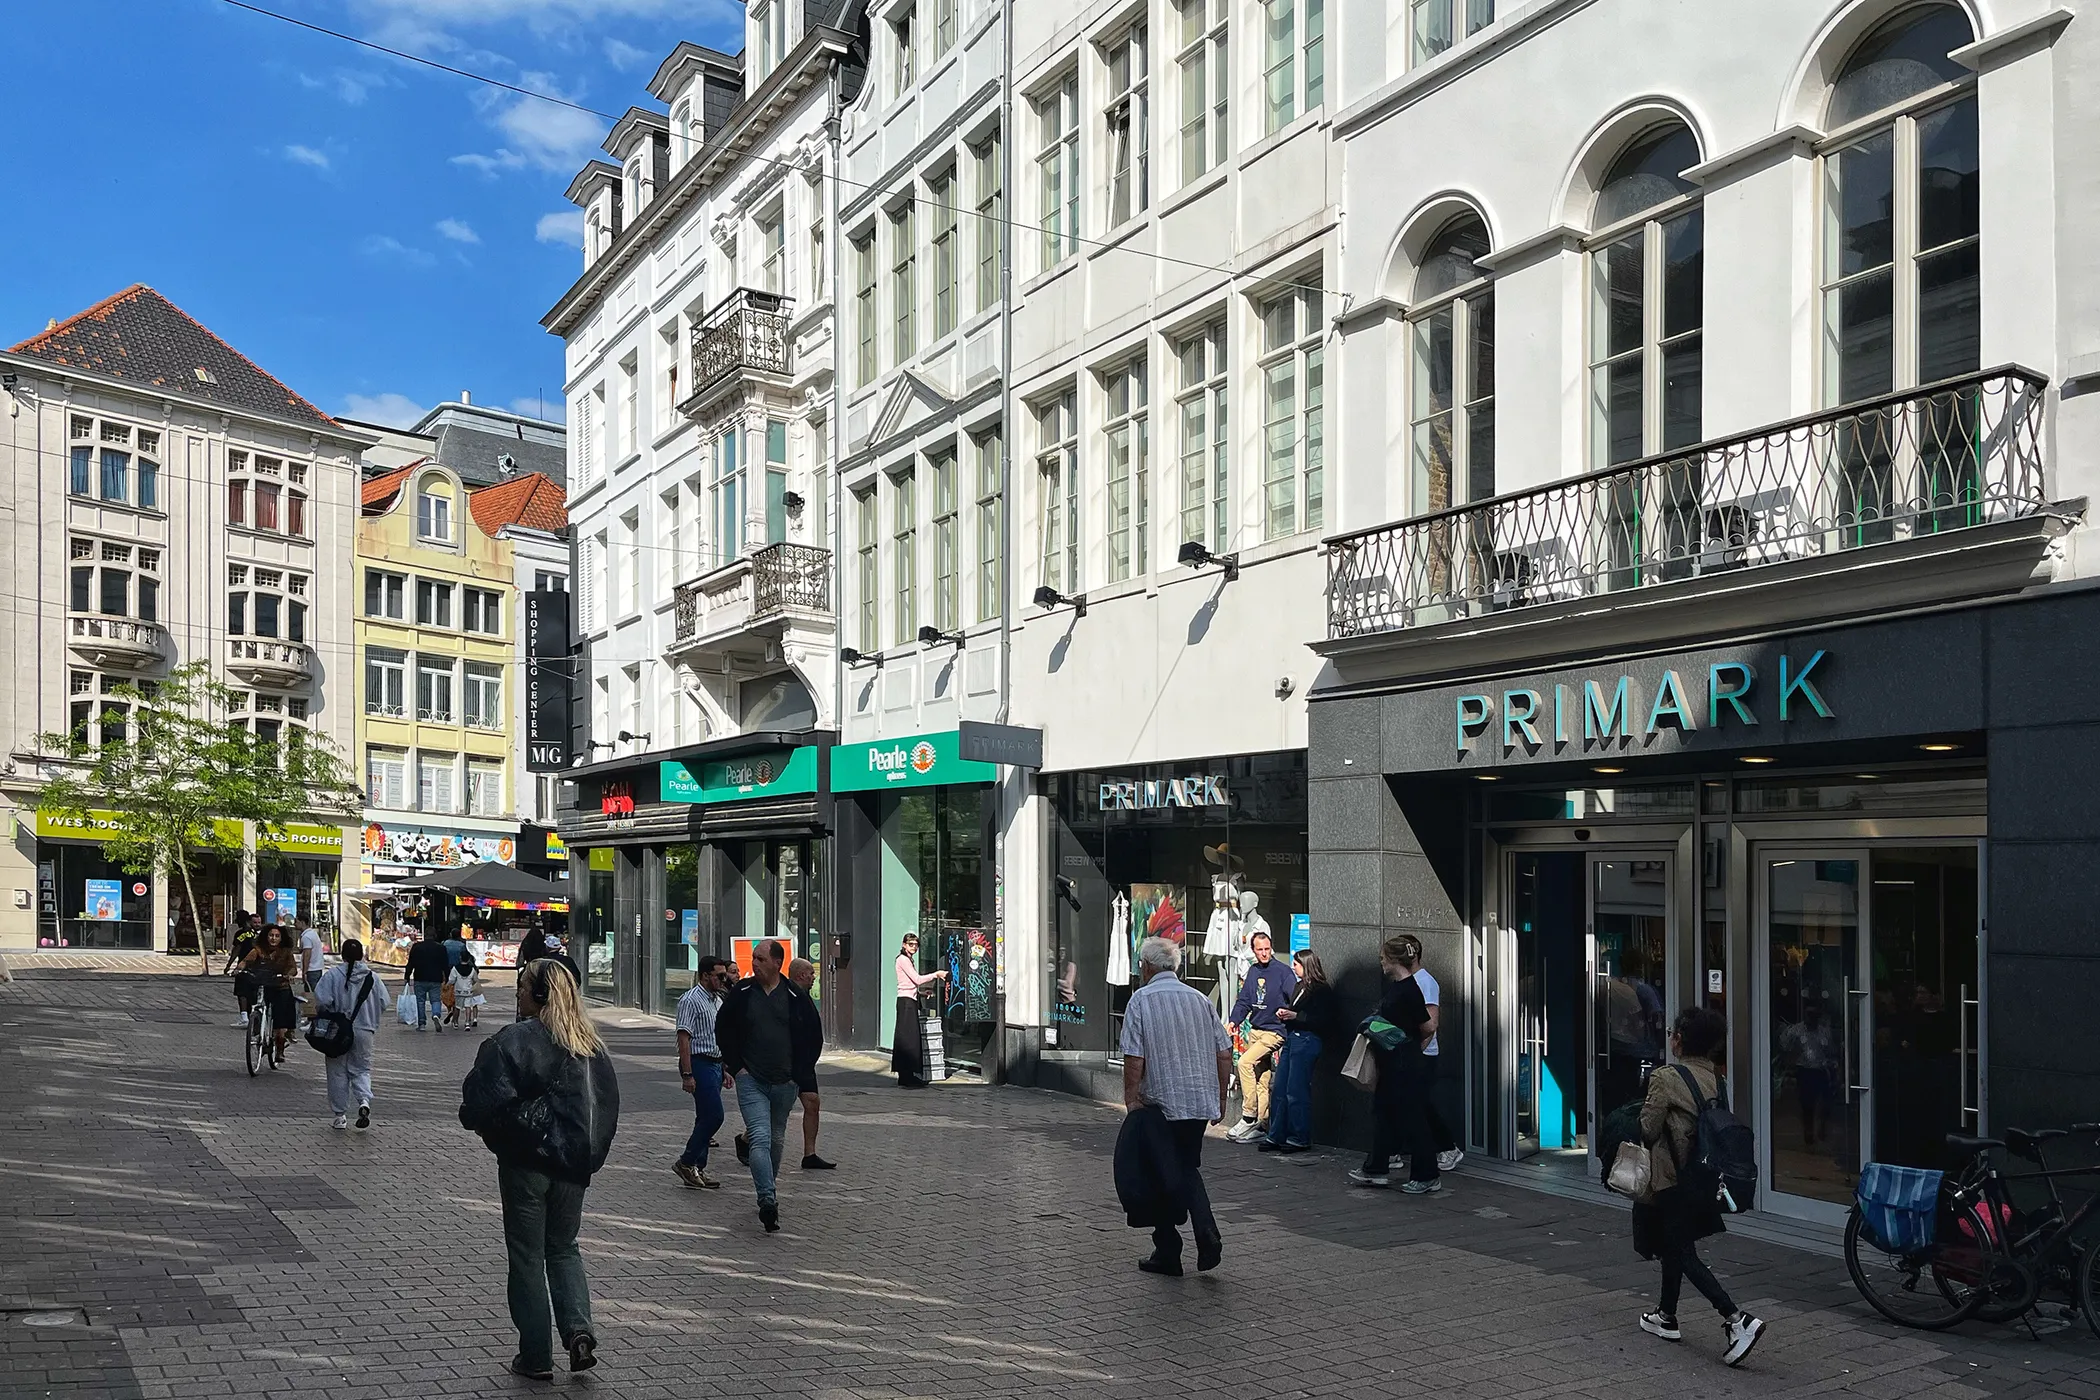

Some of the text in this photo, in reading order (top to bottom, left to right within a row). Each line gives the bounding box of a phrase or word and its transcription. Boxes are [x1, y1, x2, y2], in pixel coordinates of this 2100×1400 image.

[530, 600, 538, 738] SHOPPING CENTER
[1457, 650, 1835, 751] PRIMARK
[869, 744, 907, 771] Pearle
[725, 763, 753, 785] Pearle
[669, 781, 699, 792] Pearle
[1100, 775, 1227, 810] PRIMARK
[46, 816, 83, 828] YVES
[291, 834, 342, 846] ROCHER
